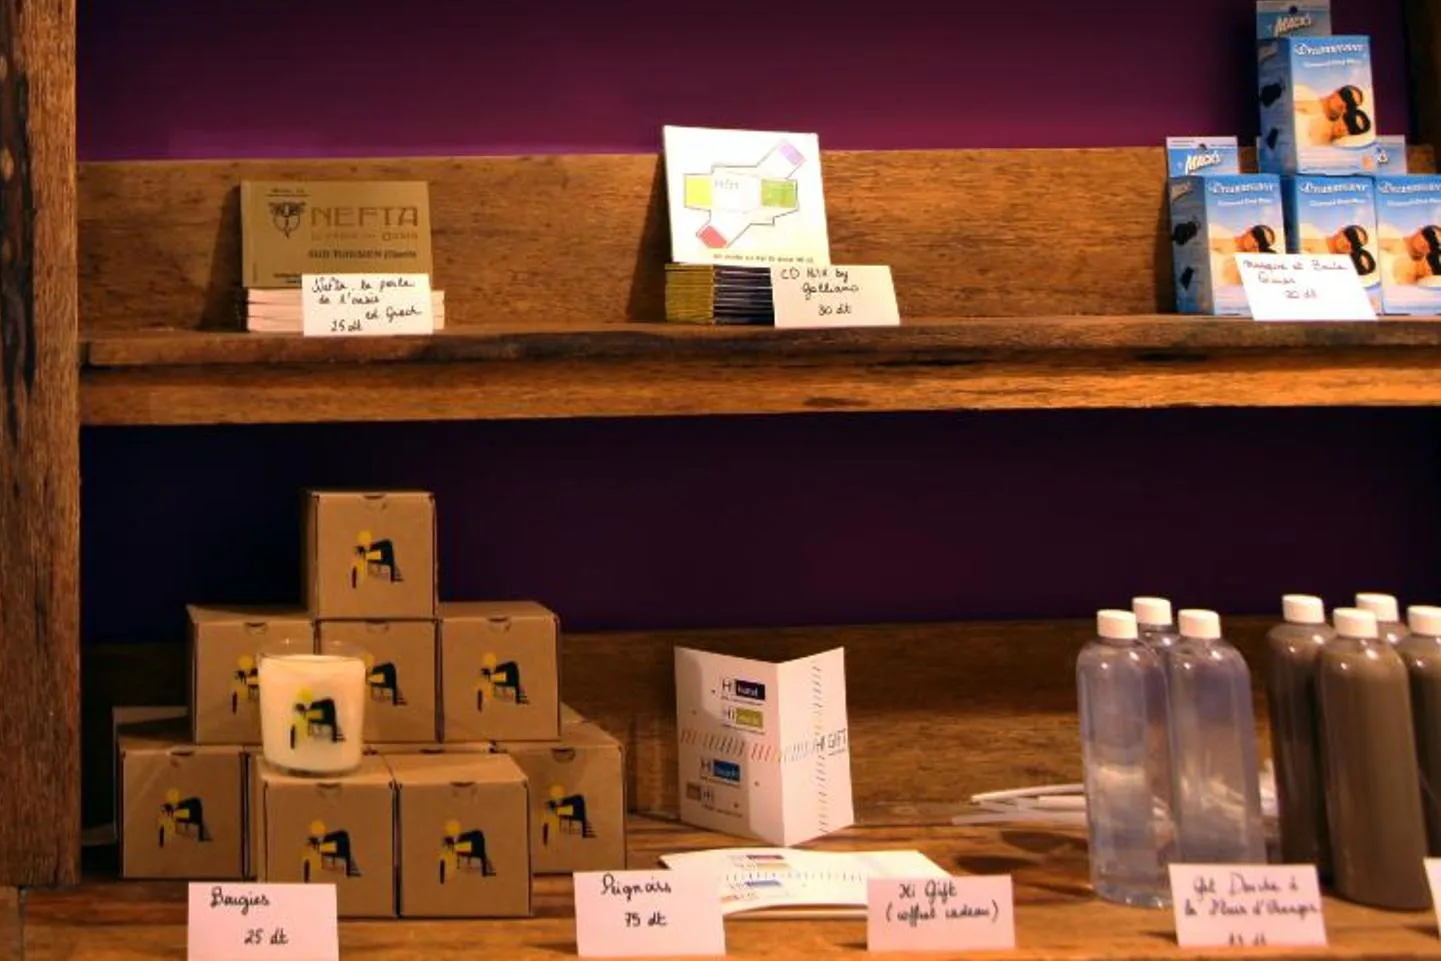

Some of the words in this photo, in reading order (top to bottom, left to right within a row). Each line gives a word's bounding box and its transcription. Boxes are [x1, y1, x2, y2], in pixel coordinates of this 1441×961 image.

[310, 206, 420, 228] NEFTA
[781, 267, 801, 280] CD
[647, 911, 668, 927] dt
[243, 927, 264, 945] 25
[269, 927, 289, 945] dt
